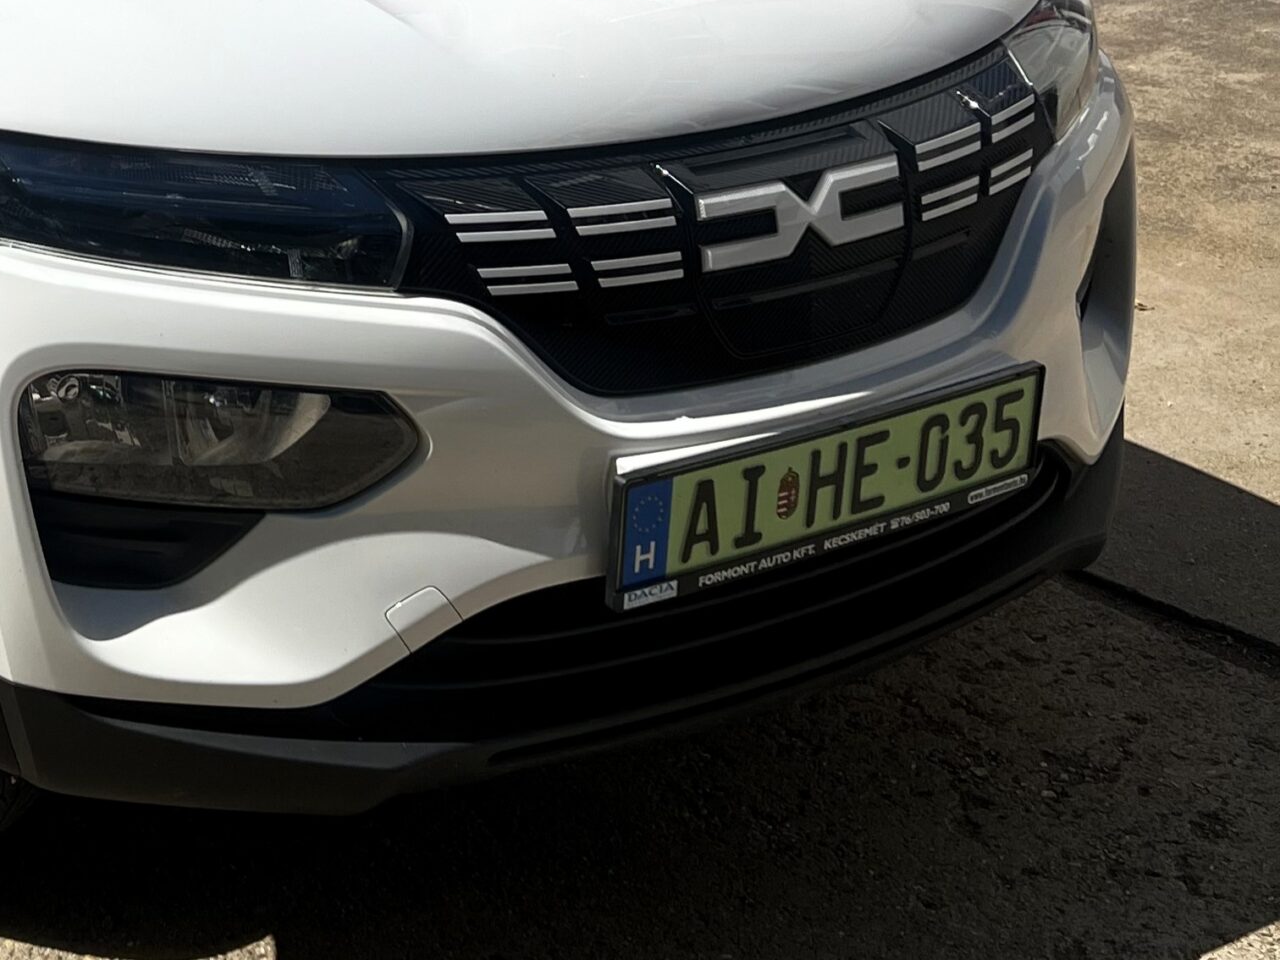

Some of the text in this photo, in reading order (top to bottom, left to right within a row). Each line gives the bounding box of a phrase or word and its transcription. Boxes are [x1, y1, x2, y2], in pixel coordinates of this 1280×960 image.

[681, 389, 1025, 564] AI HE-035
[634, 541, 656, 573] H
[698, 561, 758, 587] FORMONT
[758, 551, 791, 572] AUTO
[792, 543, 816, 561] KFT.
[824, 521, 887, 550] KECSKEMÉT
[627, 580, 677, 603] DACIA
